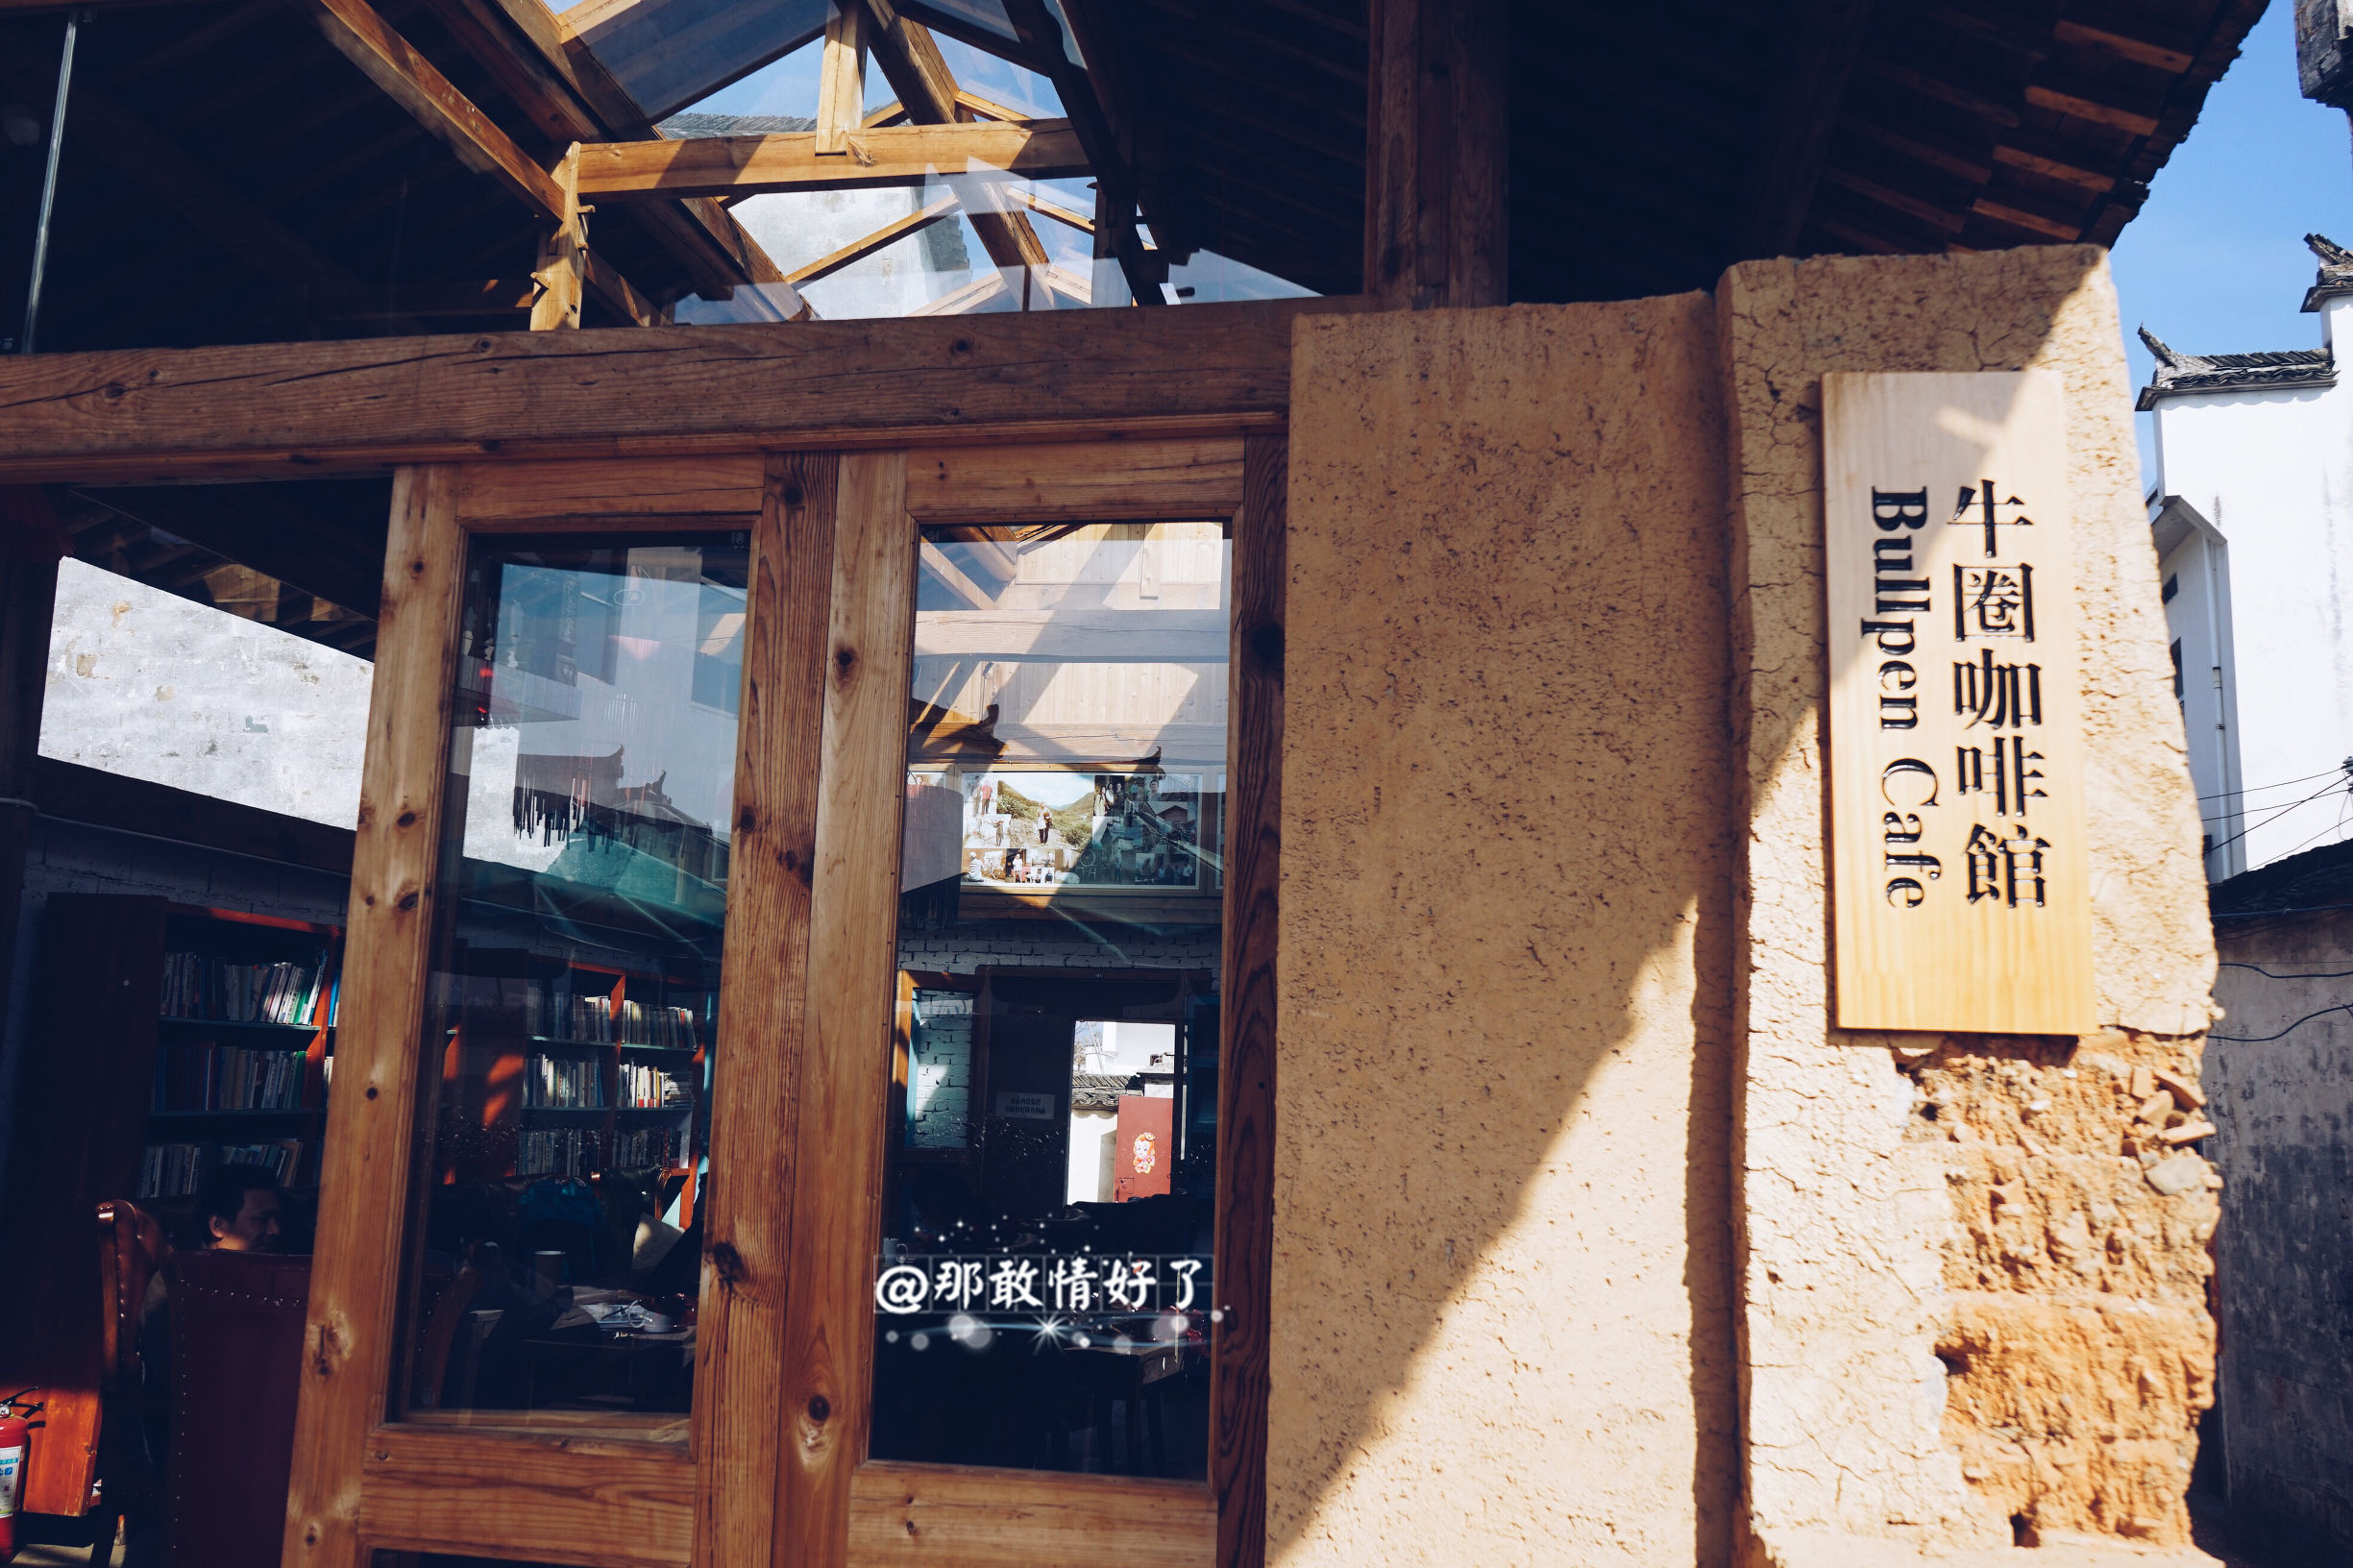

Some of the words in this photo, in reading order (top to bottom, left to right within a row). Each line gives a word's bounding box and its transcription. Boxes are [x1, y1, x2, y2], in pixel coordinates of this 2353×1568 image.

[1859, 485, 1931, 731] Bullpen
[1947, 478, 2052, 909] 牛圈咖啡館
[1881, 757, 1942, 909] Cafe
